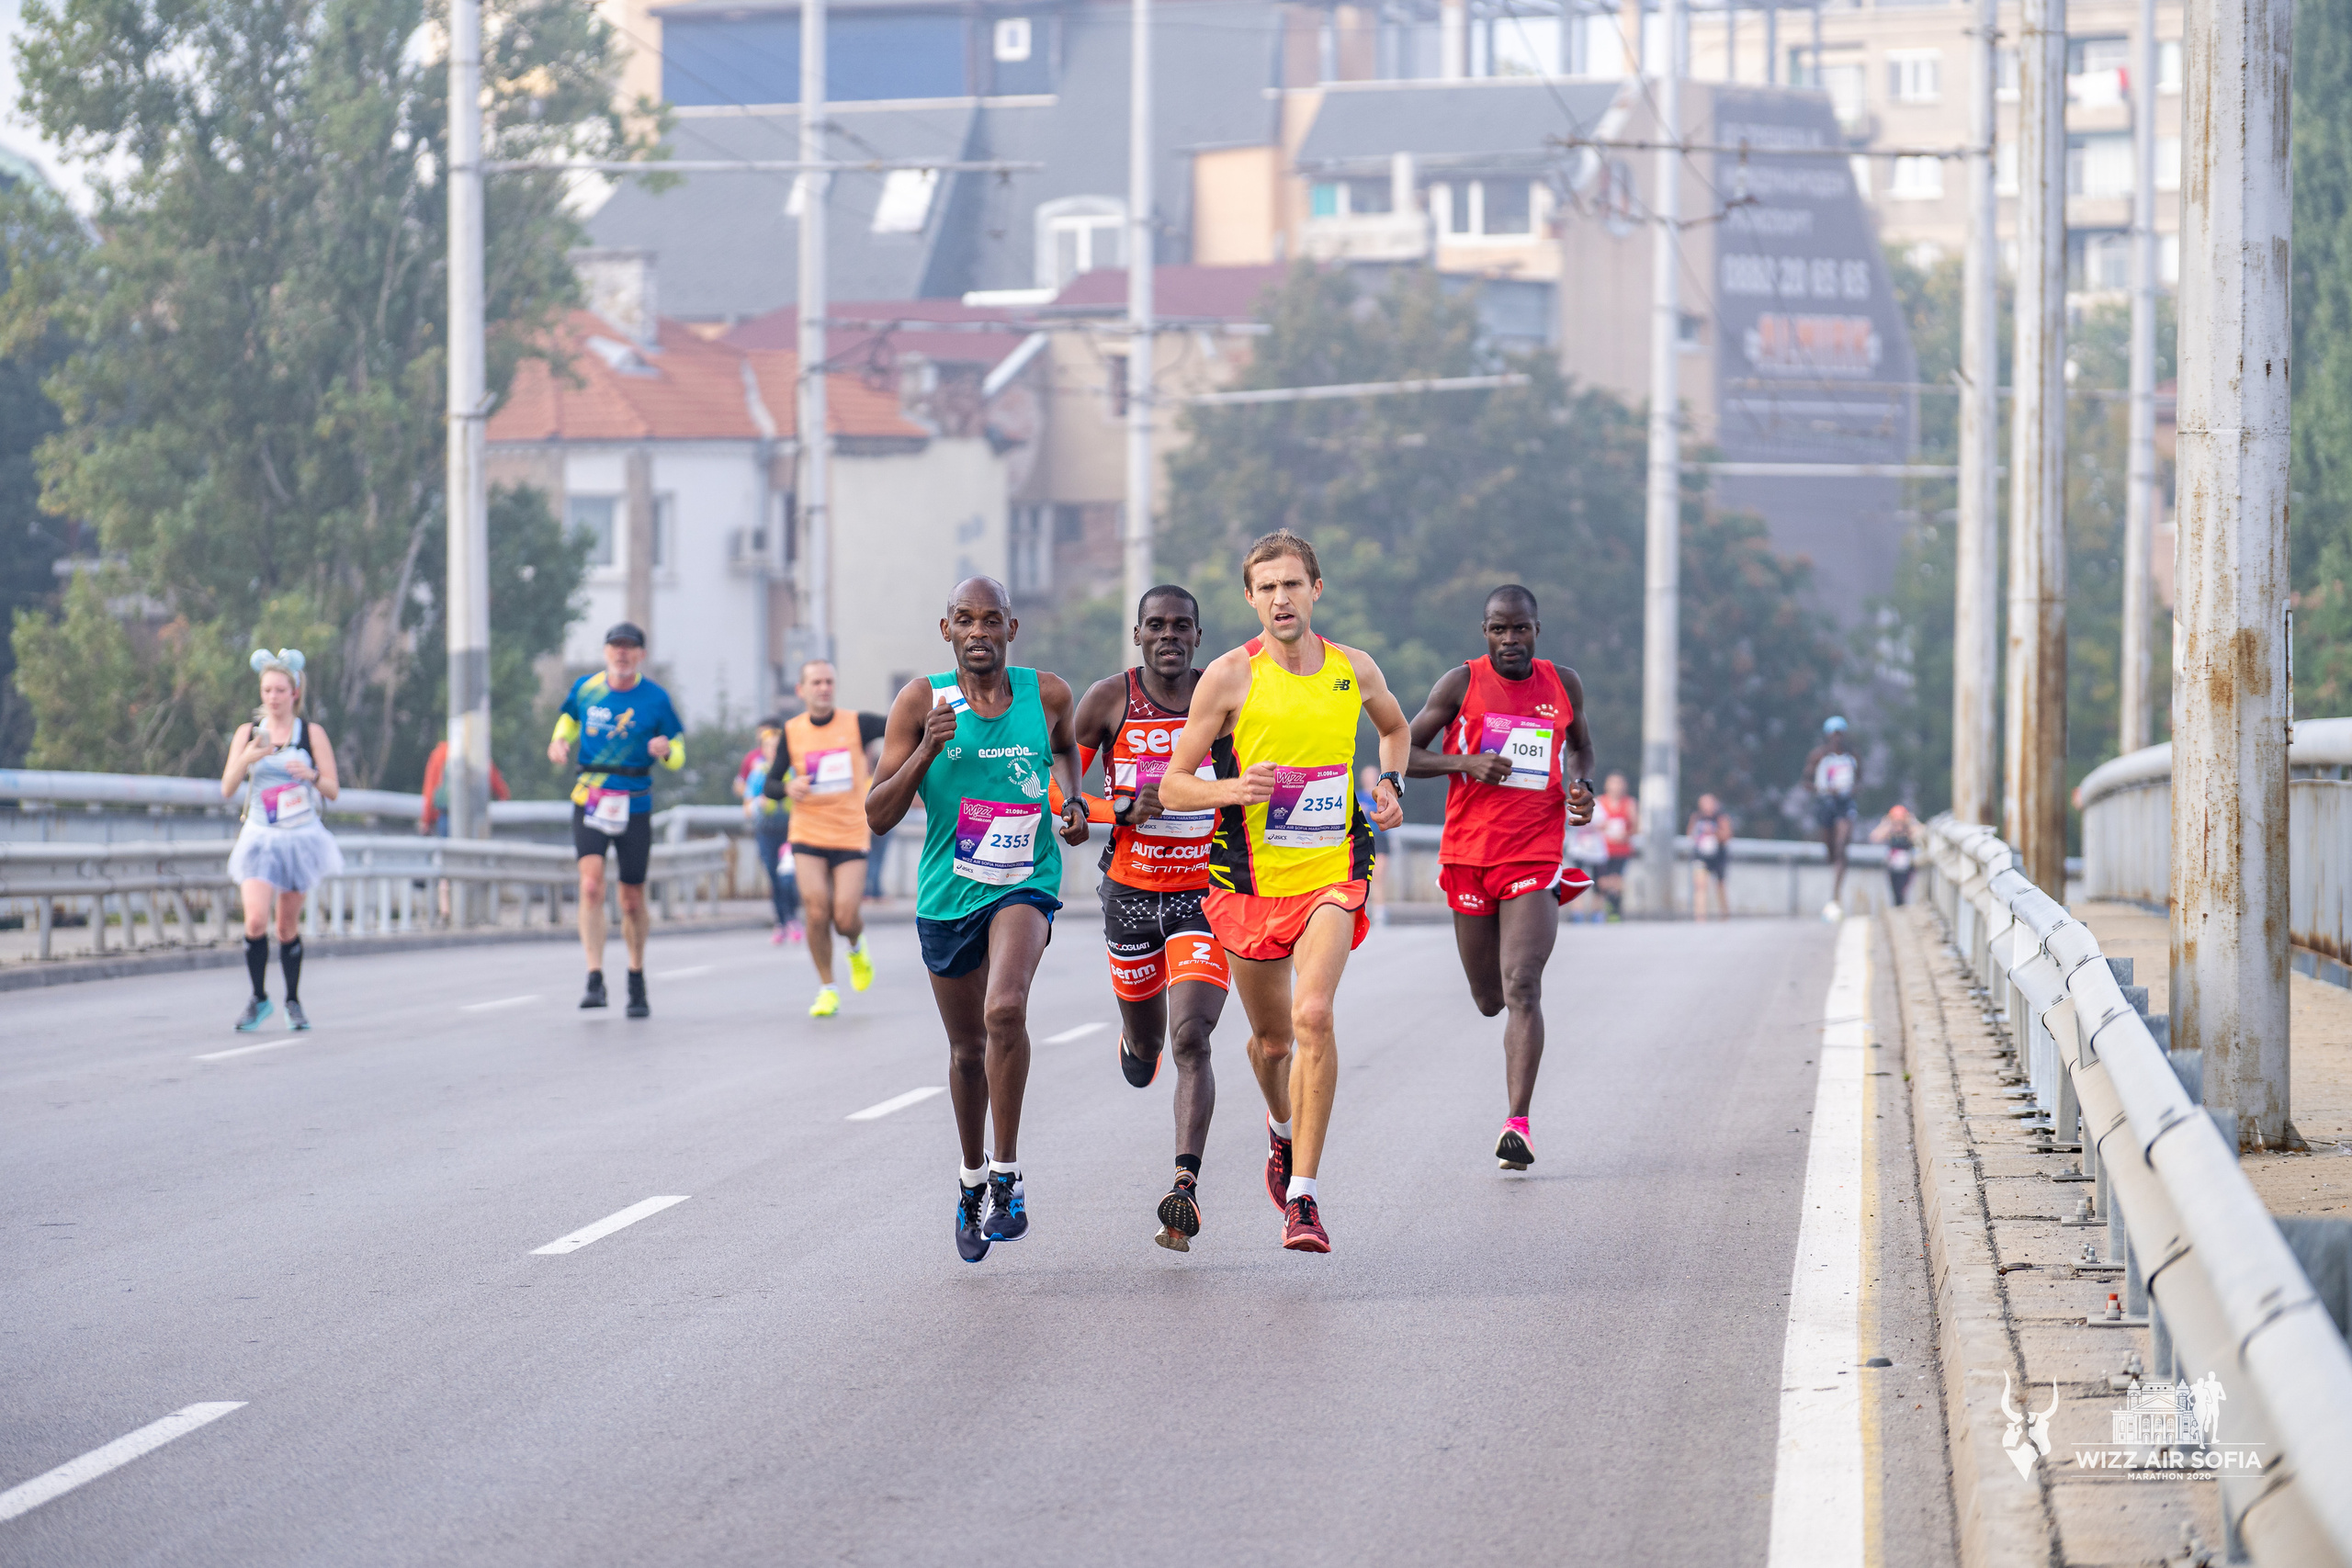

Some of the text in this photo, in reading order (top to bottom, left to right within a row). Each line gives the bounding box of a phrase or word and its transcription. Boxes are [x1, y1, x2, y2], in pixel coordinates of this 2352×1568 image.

[1126, 728, 1183, 753] ser
[978, 743, 1033, 758] ecoverde
[1512, 743, 1544, 758] 1081
[1303, 795, 1342, 811] 2354
[990, 833, 1030, 849] 2353
[1130, 841, 1213, 859] AUTOCOGLIAT
[1519, 878, 1537, 888] asics
[1111, 964, 1156, 980] serim
